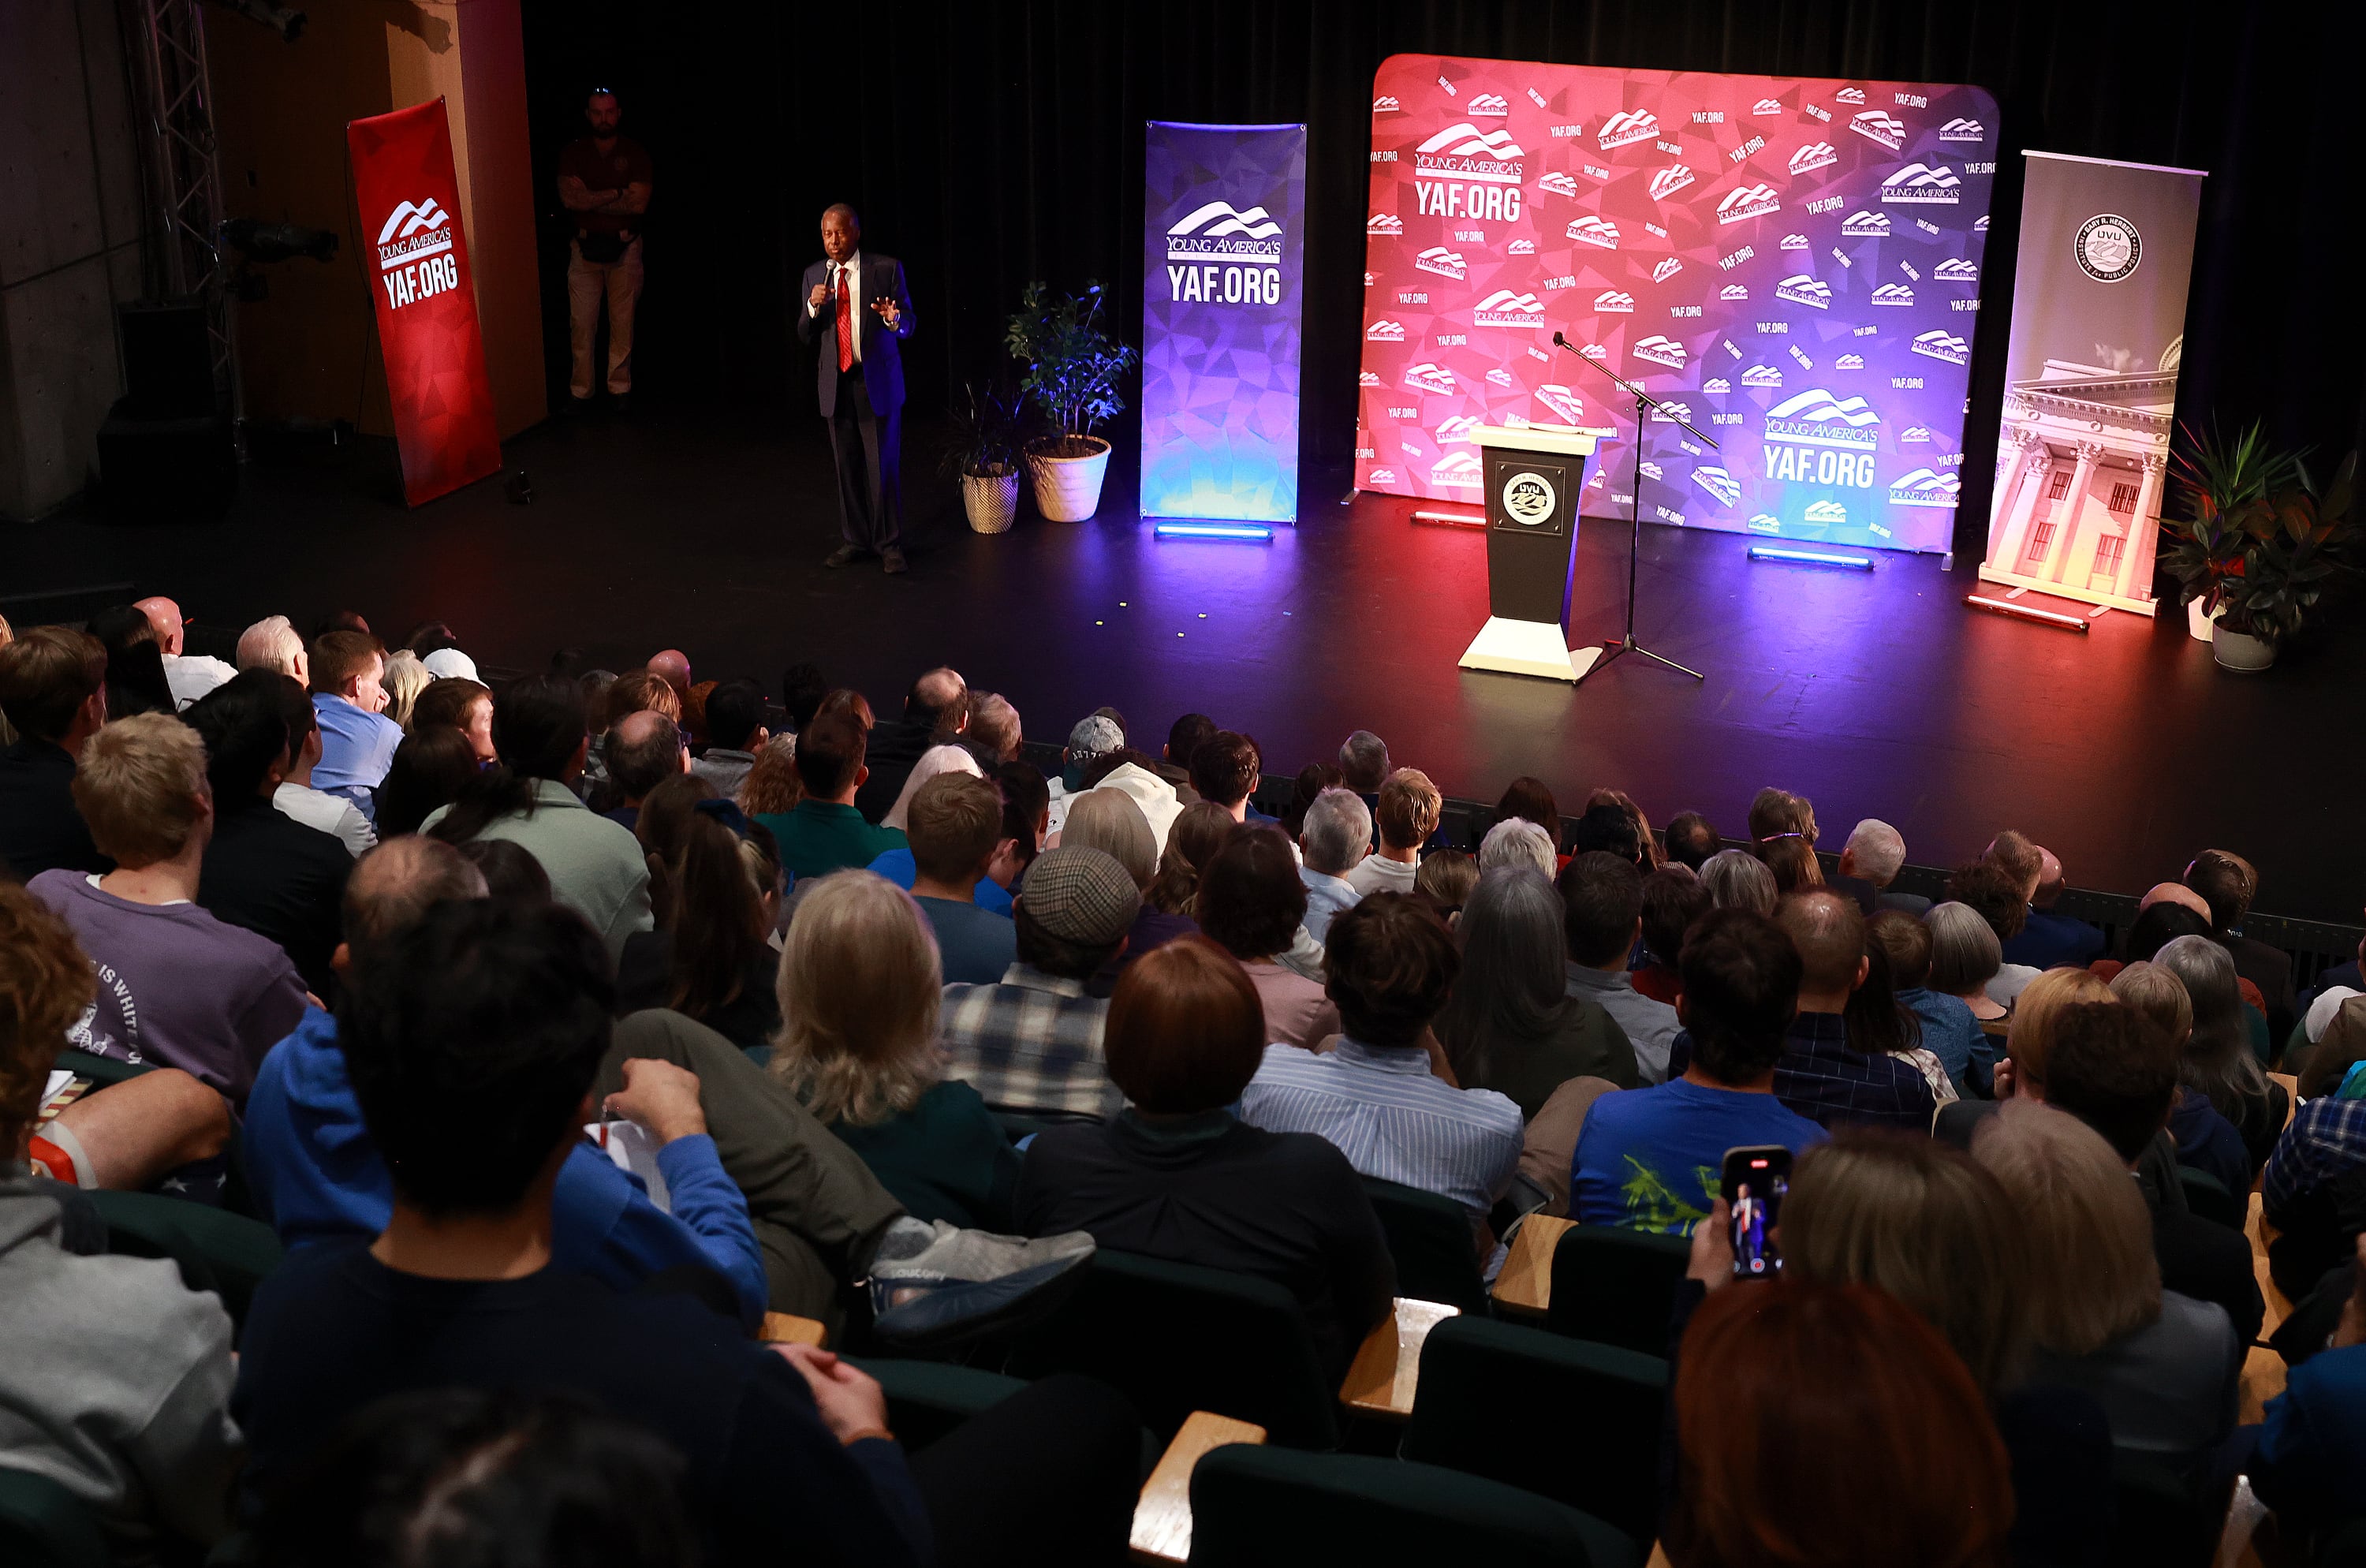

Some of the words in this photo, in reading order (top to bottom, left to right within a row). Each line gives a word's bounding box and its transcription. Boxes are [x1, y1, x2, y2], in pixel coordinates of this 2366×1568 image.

[1894, 91, 1928, 109] YAF.ORG
[1692, 111, 1724, 124] YAF.ORG
[1805, 103, 1832, 123] YAF.ORG
[1550, 125, 1582, 138] YAF.ORG
[1598, 133, 1623, 146] YOUNG
[1623, 122, 1659, 140] AMERICA'S
[1656, 140, 1683, 156] YAF.ORG
[1729, 135, 1766, 164] YAF.ORG
[1415, 154, 1457, 169] YOUNG
[1458, 158, 1524, 176] AMERICA'S
[1583, 163, 1610, 180] YAF.ORG
[1881, 186, 1912, 197] YOUNG
[1913, 187, 1960, 198] AMERICA'S
[1414, 181, 1521, 222] YAF.ORG
[1717, 208, 1742, 220] YOUNG
[1742, 197, 1780, 215] AMERICA'S
[1805, 196, 1844, 216] YAF.ORG
[1644, 221, 1669, 239] YAF.ORG
[1916, 218, 1941, 236] YAF.ORG
[2084, 218, 2100, 233] GARY
[2109, 218, 2136, 239] HERBERT
[2098, 230, 2122, 241] UVU
[377, 241, 406, 261] YOUNG
[407, 226, 451, 252] AMERICA'S
[1166, 236, 1211, 252] YOUNG
[1212, 237, 1281, 255] AMERICA'S
[1454, 230, 1484, 243] YAF.ORG
[1718, 245, 1756, 272] YAF.ORG
[2077, 236, 2093, 272] INSTITUTE
[2103, 267, 2129, 279] PUBLIC
[2126, 243, 2140, 268] POLICY
[383, 253, 458, 310] YAF.ORG
[1166, 265, 1281, 305] YAF.ORG
[1543, 275, 1577, 291] YAF.ORG
[1398, 293, 1428, 304] YAF.ORG
[1473, 312, 1502, 322] YOUNG
[1503, 312, 1545, 323] AMERICA'S
[1670, 305, 1703, 318] YAF.ORG
[1756, 322, 1789, 334] YAF.ORG
[1853, 325, 1879, 338] YAF.ORG
[1436, 334, 1467, 346] YAF.ORG
[1890, 377, 1924, 390] YAF.ORG
[1388, 407, 1417, 419] YAF.ORG
[1711, 413, 1744, 425] YAF.ORG
[1764, 417, 1809, 435] YOUNG
[1810, 423, 1879, 442] AMERICA'S
[1679, 439, 1703, 457] YAF.ORG
[1763, 444, 1875, 489] YAF.ORG
[1432, 471, 1458, 481] YOUNG
[1519, 483, 1540, 494] UVU
[1889, 489, 1919, 500] YOUNG
[1920, 490, 1960, 502] AMERICA
[1610, 494, 1633, 505] YAF.ORG
[1656, 504, 1686, 526] YAF.ORG
[98, 964, 116, 984] IS
